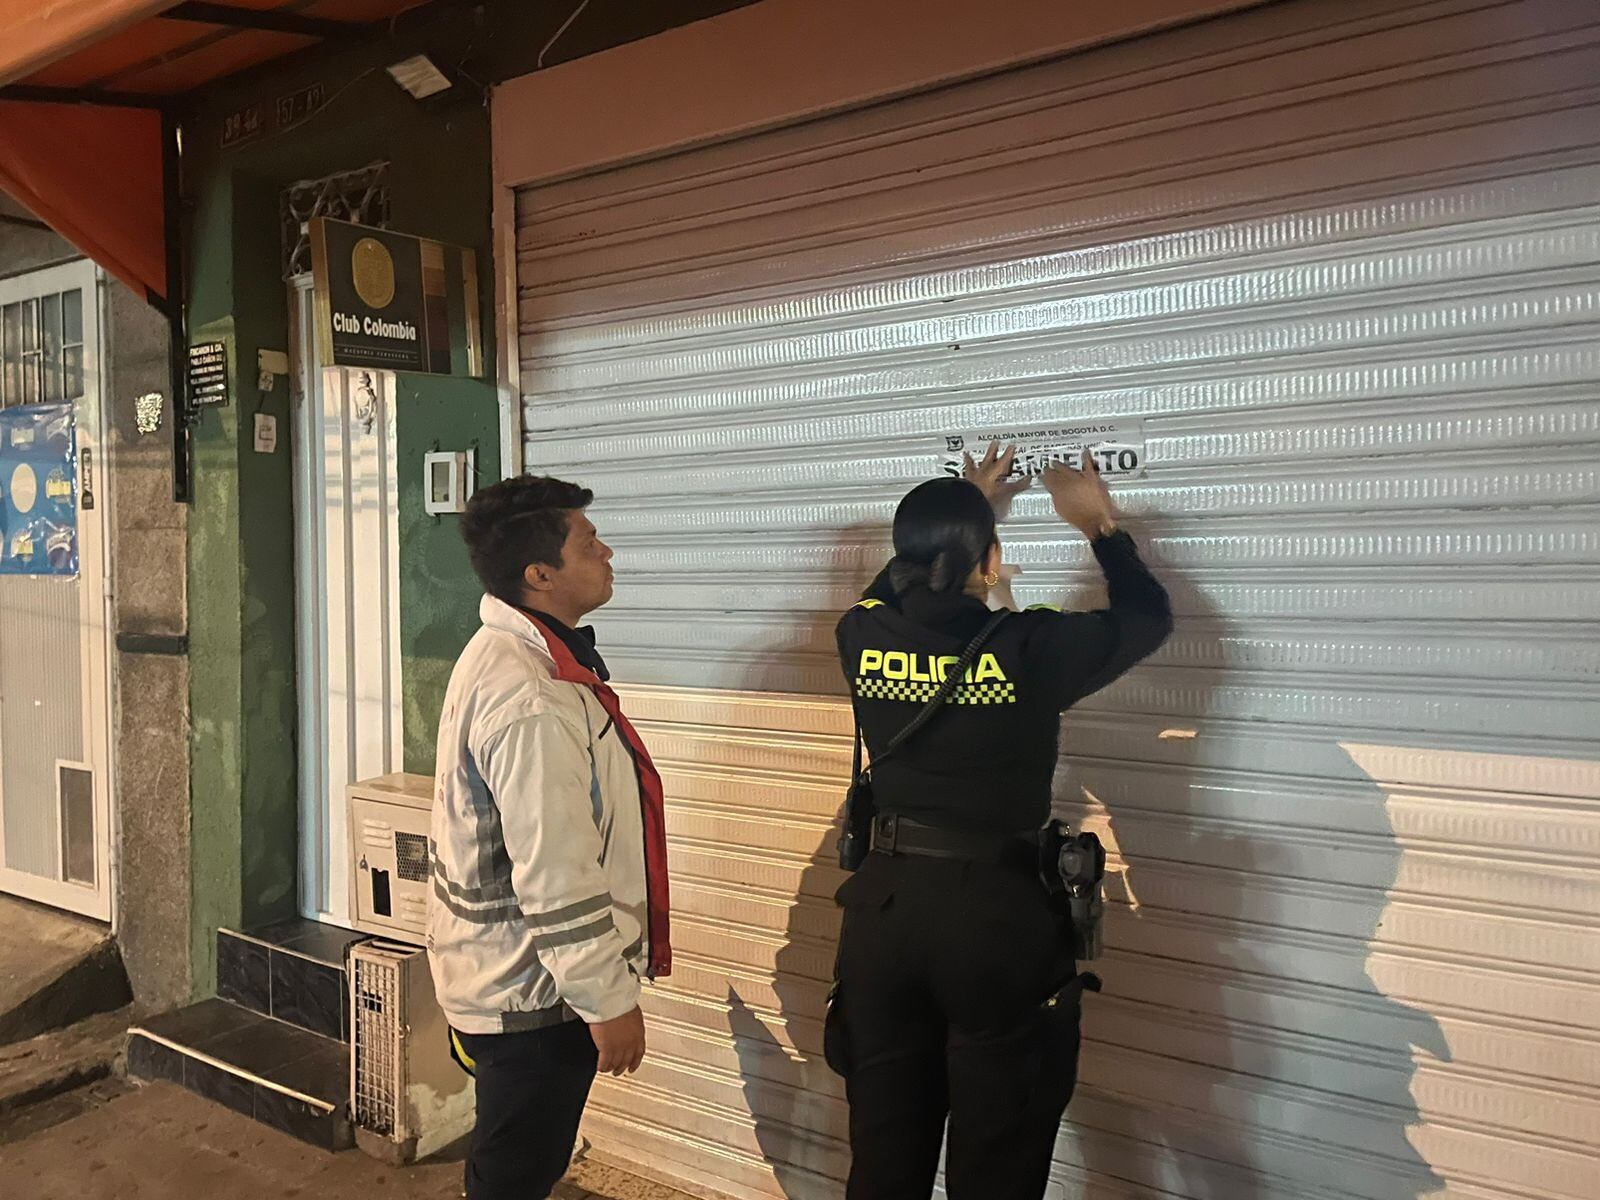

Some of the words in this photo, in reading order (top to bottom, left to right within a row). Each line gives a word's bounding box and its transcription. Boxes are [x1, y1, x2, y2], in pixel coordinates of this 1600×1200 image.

[333, 312, 360, 334] Club
[363, 316, 416, 341] Colombia
[1018, 430, 1047, 440] MAYOR
[1048, 429, 1059, 438] DE
[1062, 426, 1098, 437] BOGOTÁ
[859, 649, 1007, 684] POLICIA
